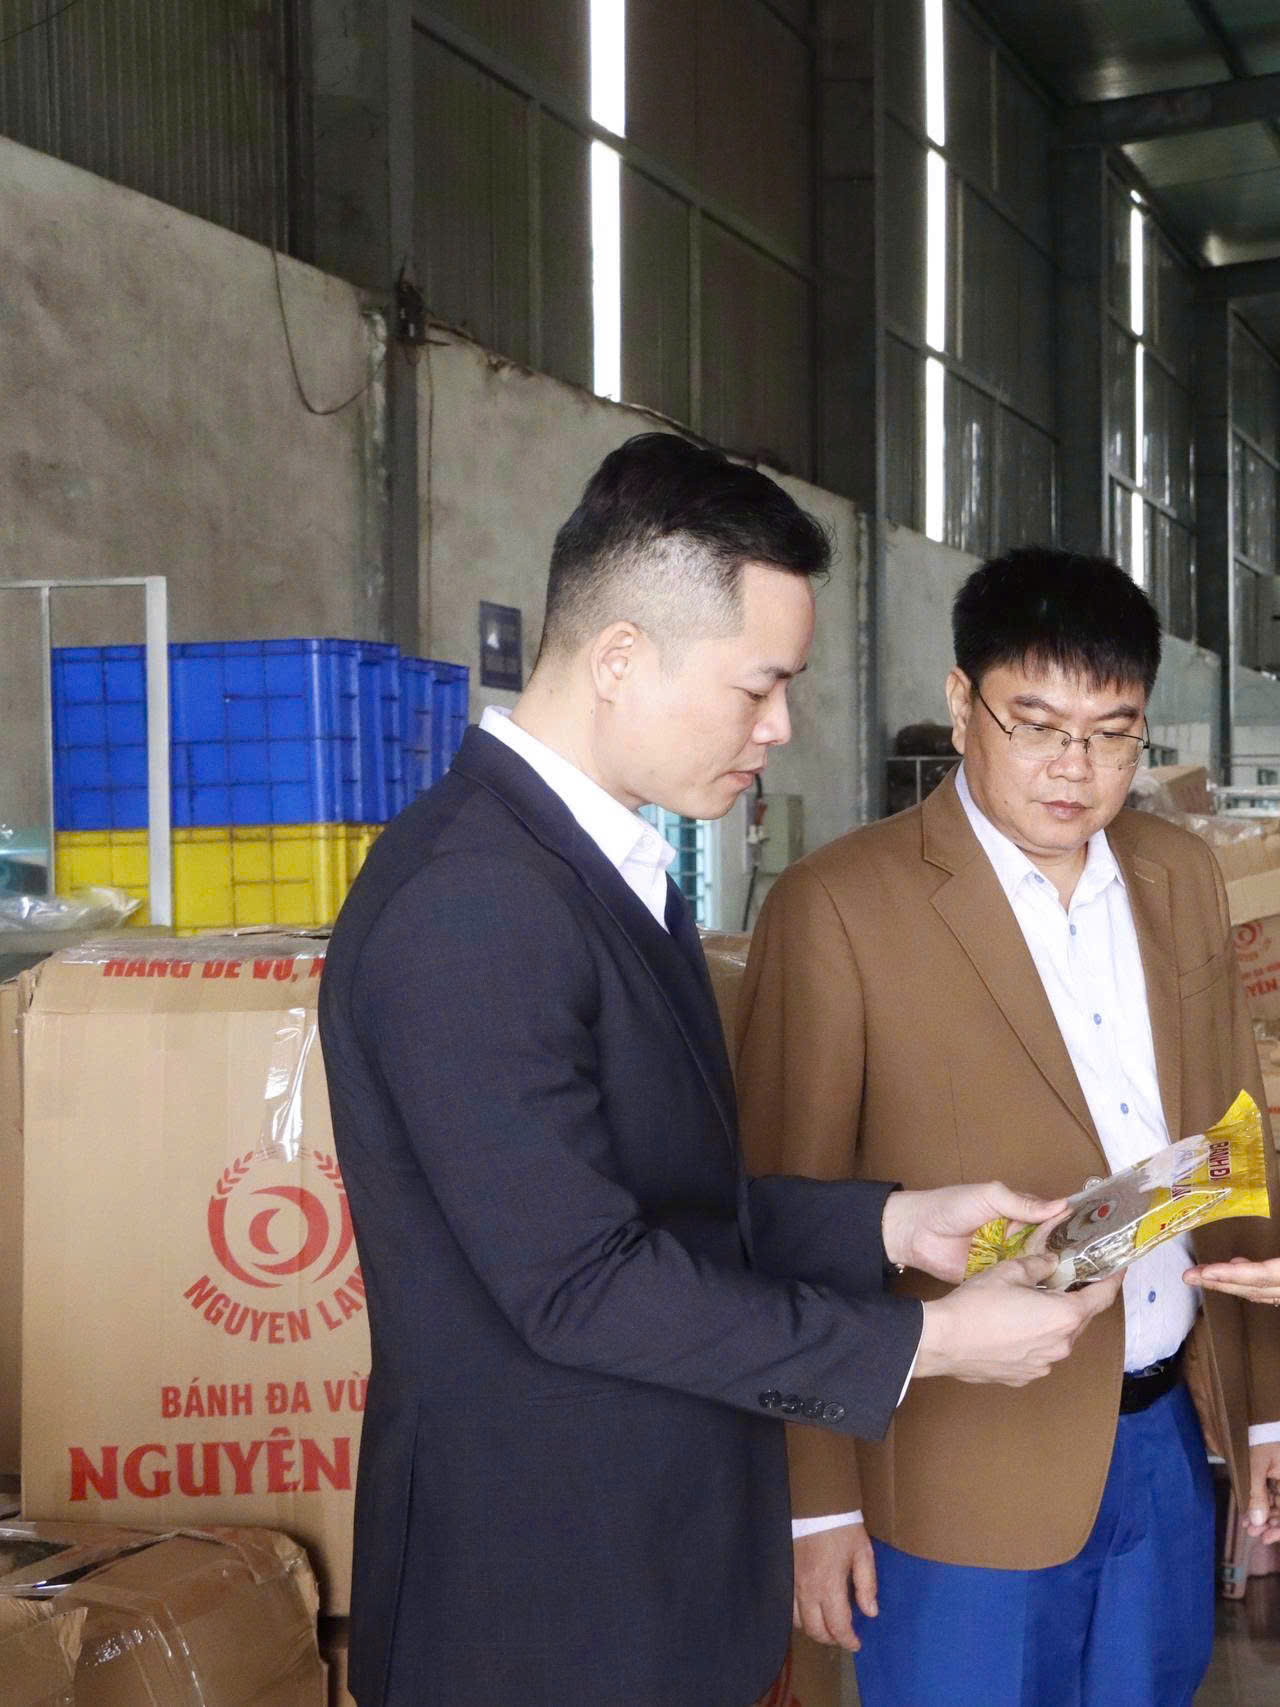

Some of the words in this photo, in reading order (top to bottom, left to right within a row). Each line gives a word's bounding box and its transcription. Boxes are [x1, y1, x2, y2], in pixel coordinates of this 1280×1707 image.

[160, 1377, 253, 1419] BÁNH
[265, 1381, 313, 1415] ĐA
[68, 1426, 353, 1501] NGUYÊN
